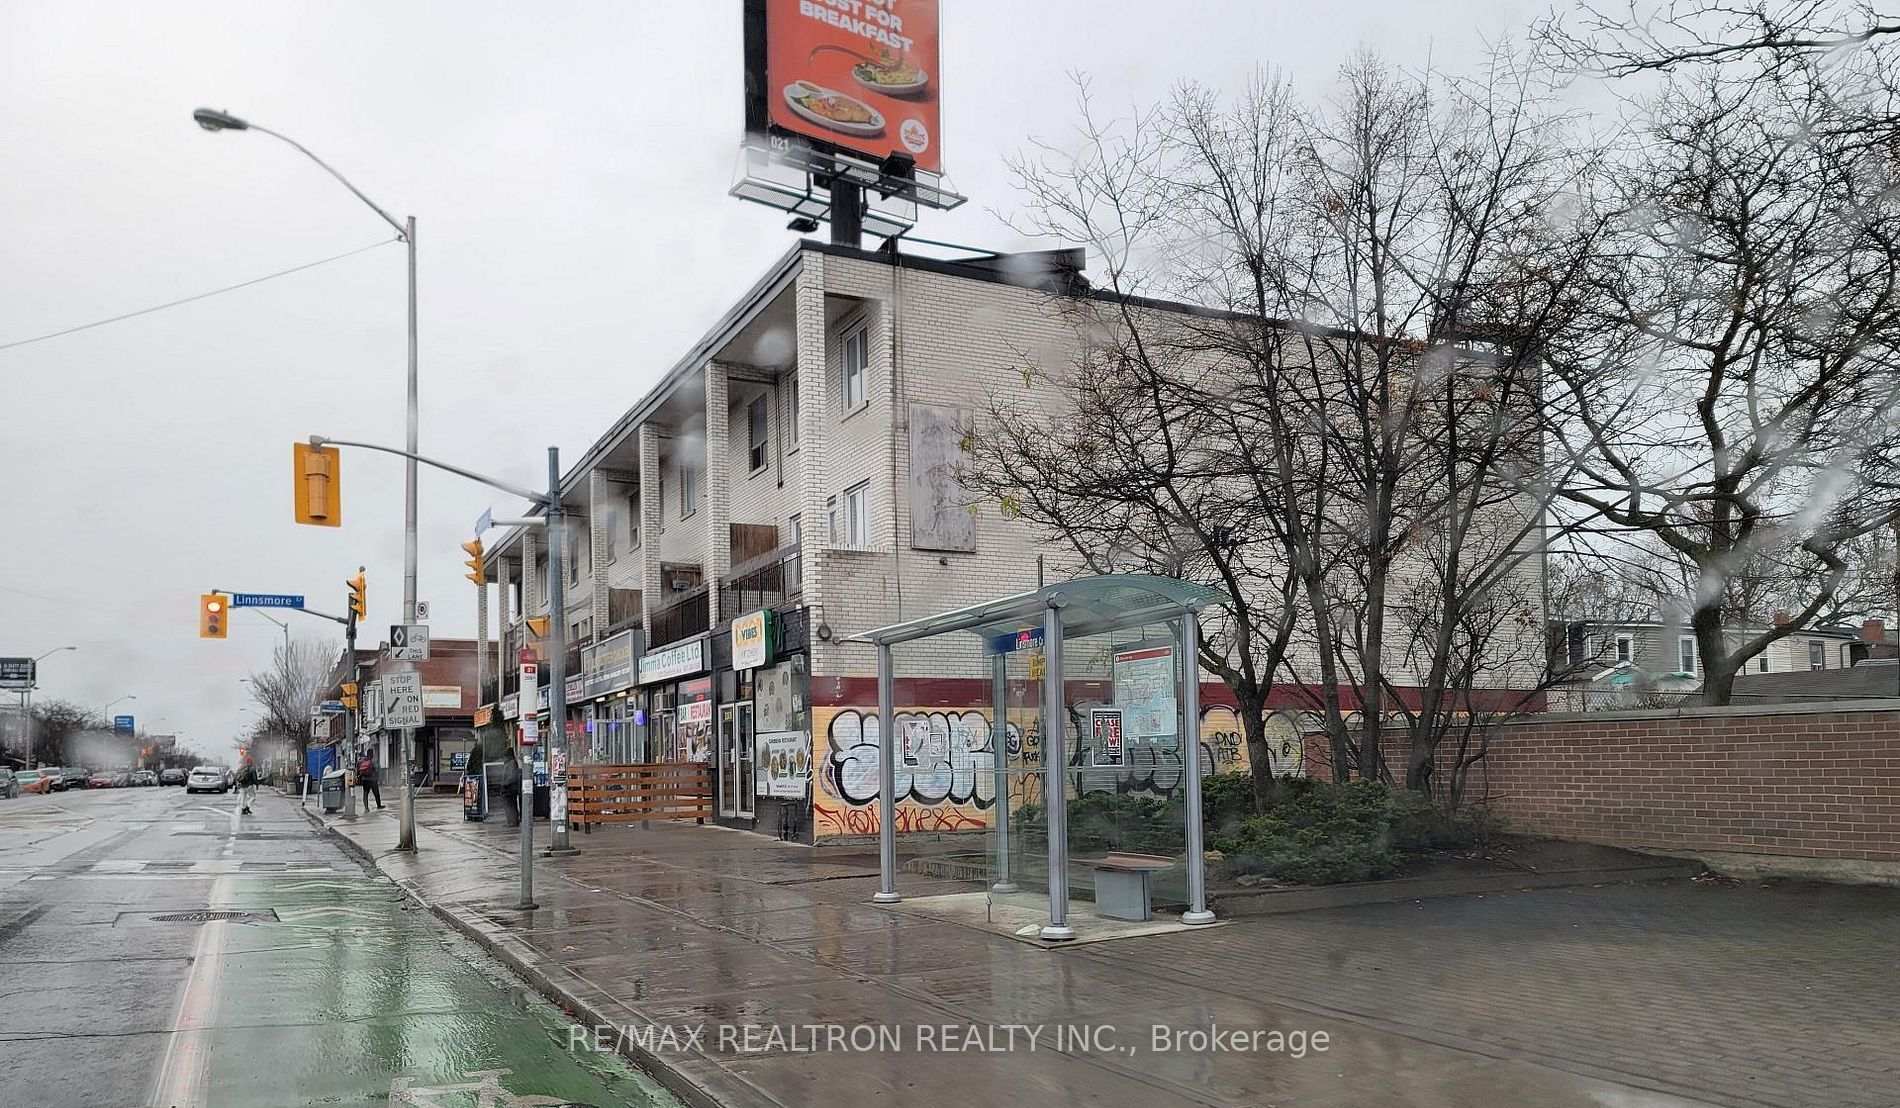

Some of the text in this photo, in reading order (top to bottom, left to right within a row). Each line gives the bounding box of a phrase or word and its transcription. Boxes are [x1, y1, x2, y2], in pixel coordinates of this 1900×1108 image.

[865, 5, 903, 33] FOR
[799, 0, 913, 52] BREAKFAST
[771, 136, 789, 150] 021
[236, 595, 292, 606] Linnsmore
[741, 626, 757, 641] VIBES
[639, 655, 661, 674] Jimma
[661, 648, 686, 668] Coffee
[390, 675, 412, 684] STOP
[391, 685, 413, 694] HERE
[407, 695, 419, 703] ON
[402, 704, 420, 714] RED
[389, 715, 419, 726] SIGNAL
